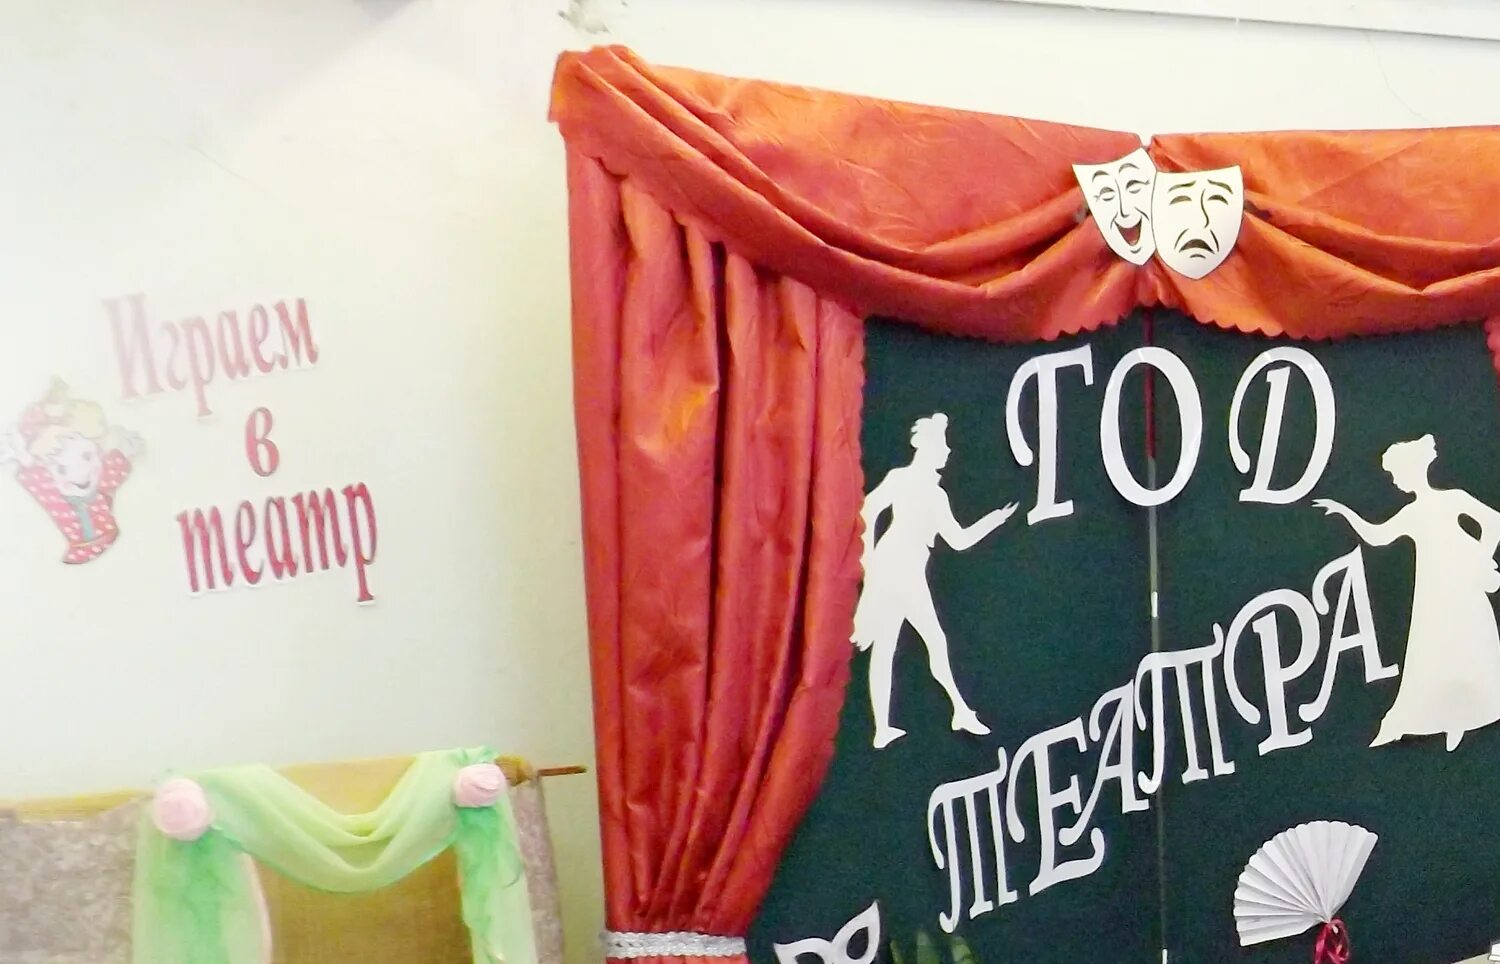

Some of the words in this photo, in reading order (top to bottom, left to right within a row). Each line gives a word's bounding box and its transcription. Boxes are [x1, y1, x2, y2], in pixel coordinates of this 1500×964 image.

[101, 293, 319, 417] Играем
[244, 406, 280, 477] в
[1005, 344, 1336, 526] ГОД
[175, 481, 378, 603] театр
[926, 544, 1399, 934] ТЕАТРА
